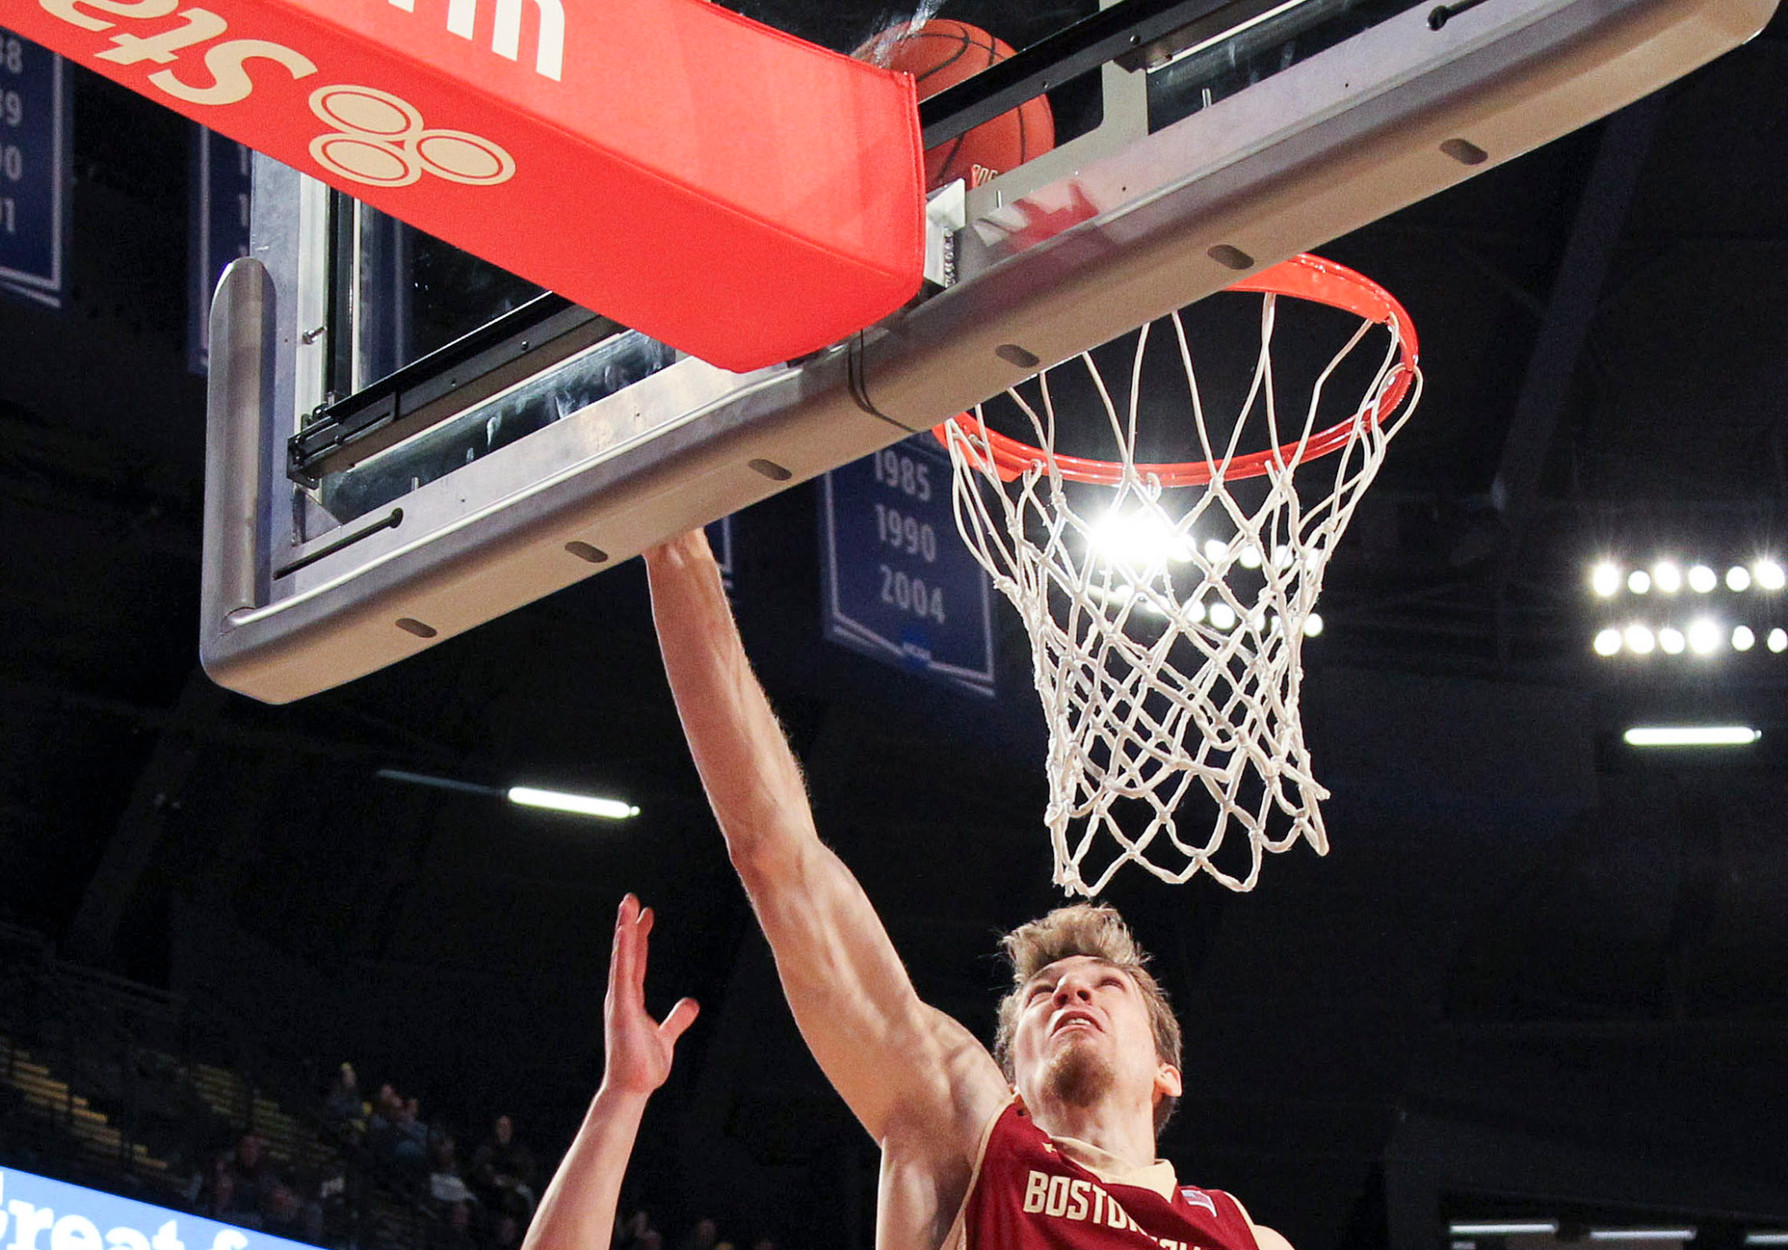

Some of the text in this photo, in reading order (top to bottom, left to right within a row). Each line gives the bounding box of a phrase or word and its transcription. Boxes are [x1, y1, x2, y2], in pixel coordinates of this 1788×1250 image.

[874, 450, 932, 502] 1985
[874, 503, 937, 563] 1990
[879, 564, 946, 625] 2004
